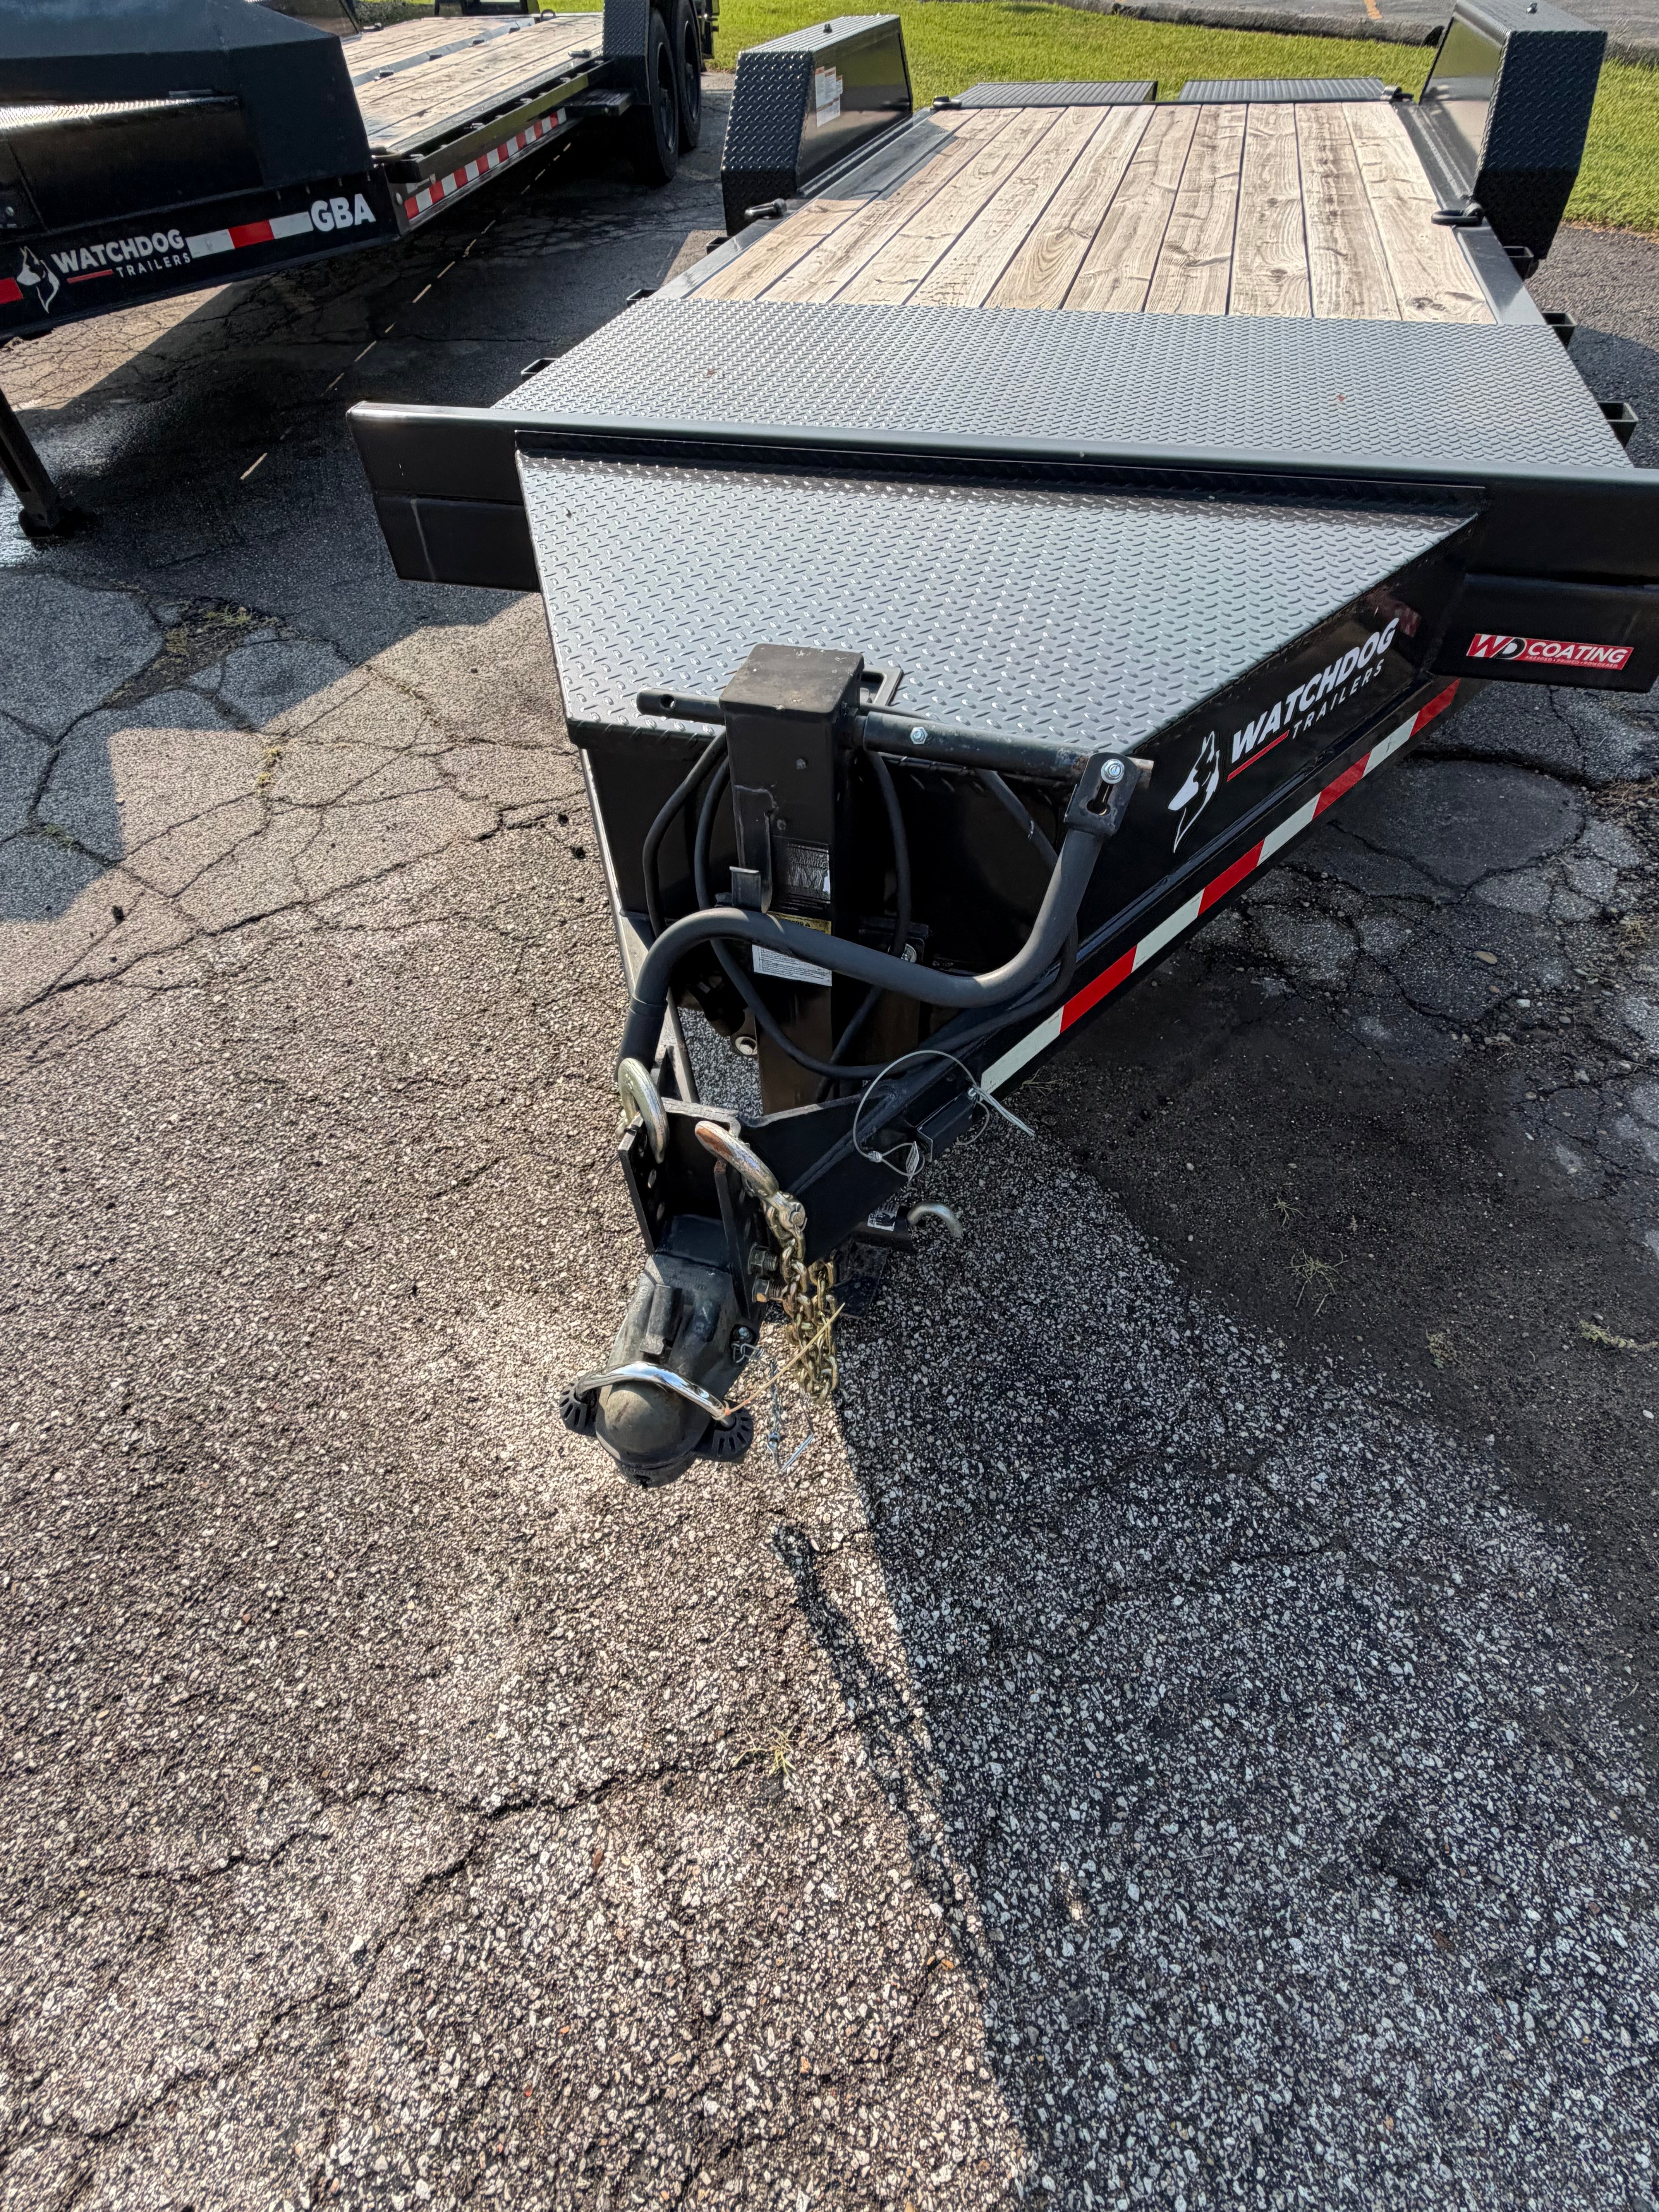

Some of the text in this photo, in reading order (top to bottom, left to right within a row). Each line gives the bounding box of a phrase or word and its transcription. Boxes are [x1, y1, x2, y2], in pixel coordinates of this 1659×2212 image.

[311, 193, 376, 232] GBA
[51, 229, 184, 273] WATCHDOG
[116, 252, 191, 278] TRAILERS
[1528, 642, 1628, 663] COATING
[1231, 618, 1399, 763] WATCHDOG
[1292, 659, 1384, 739] TRAILERS
